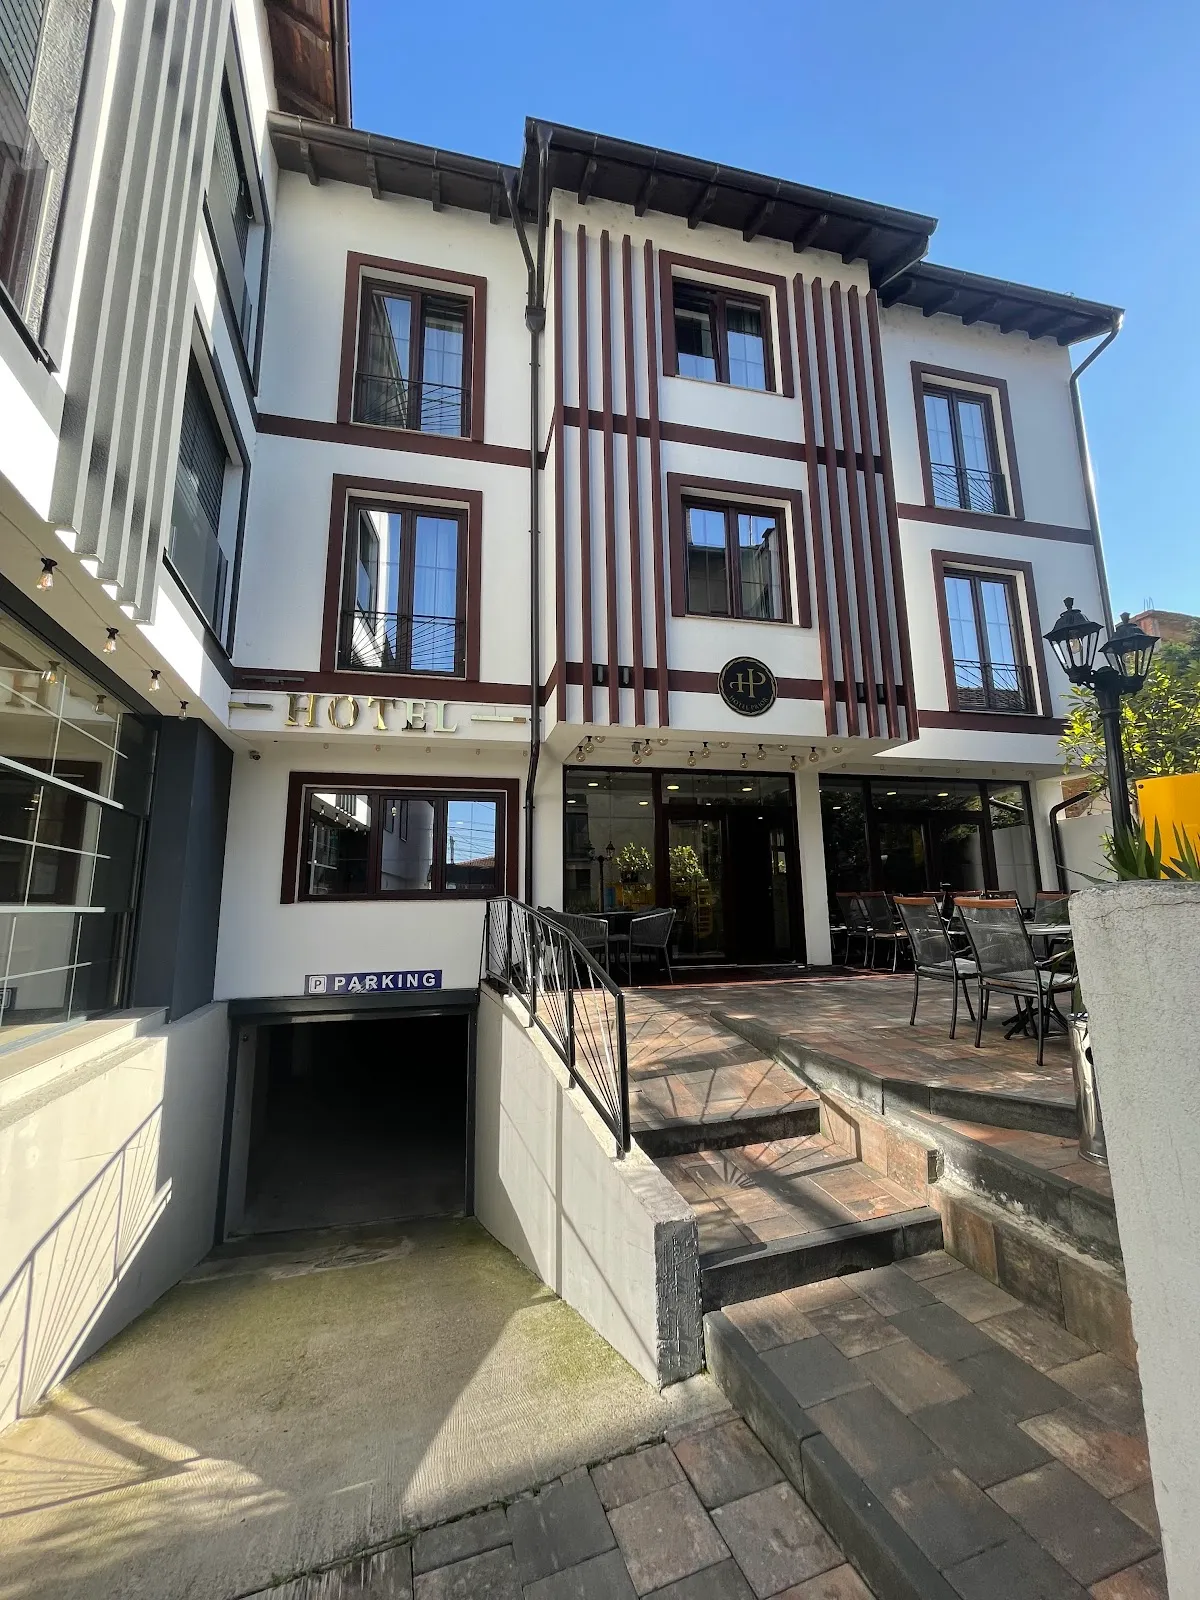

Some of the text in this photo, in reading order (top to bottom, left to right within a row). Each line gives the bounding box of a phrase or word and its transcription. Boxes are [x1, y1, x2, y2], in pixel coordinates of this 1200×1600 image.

[729, 695, 749, 710] HOTEL
[285, 693, 458, 733] HOTEL
[334, 972, 436, 991] PARKING
